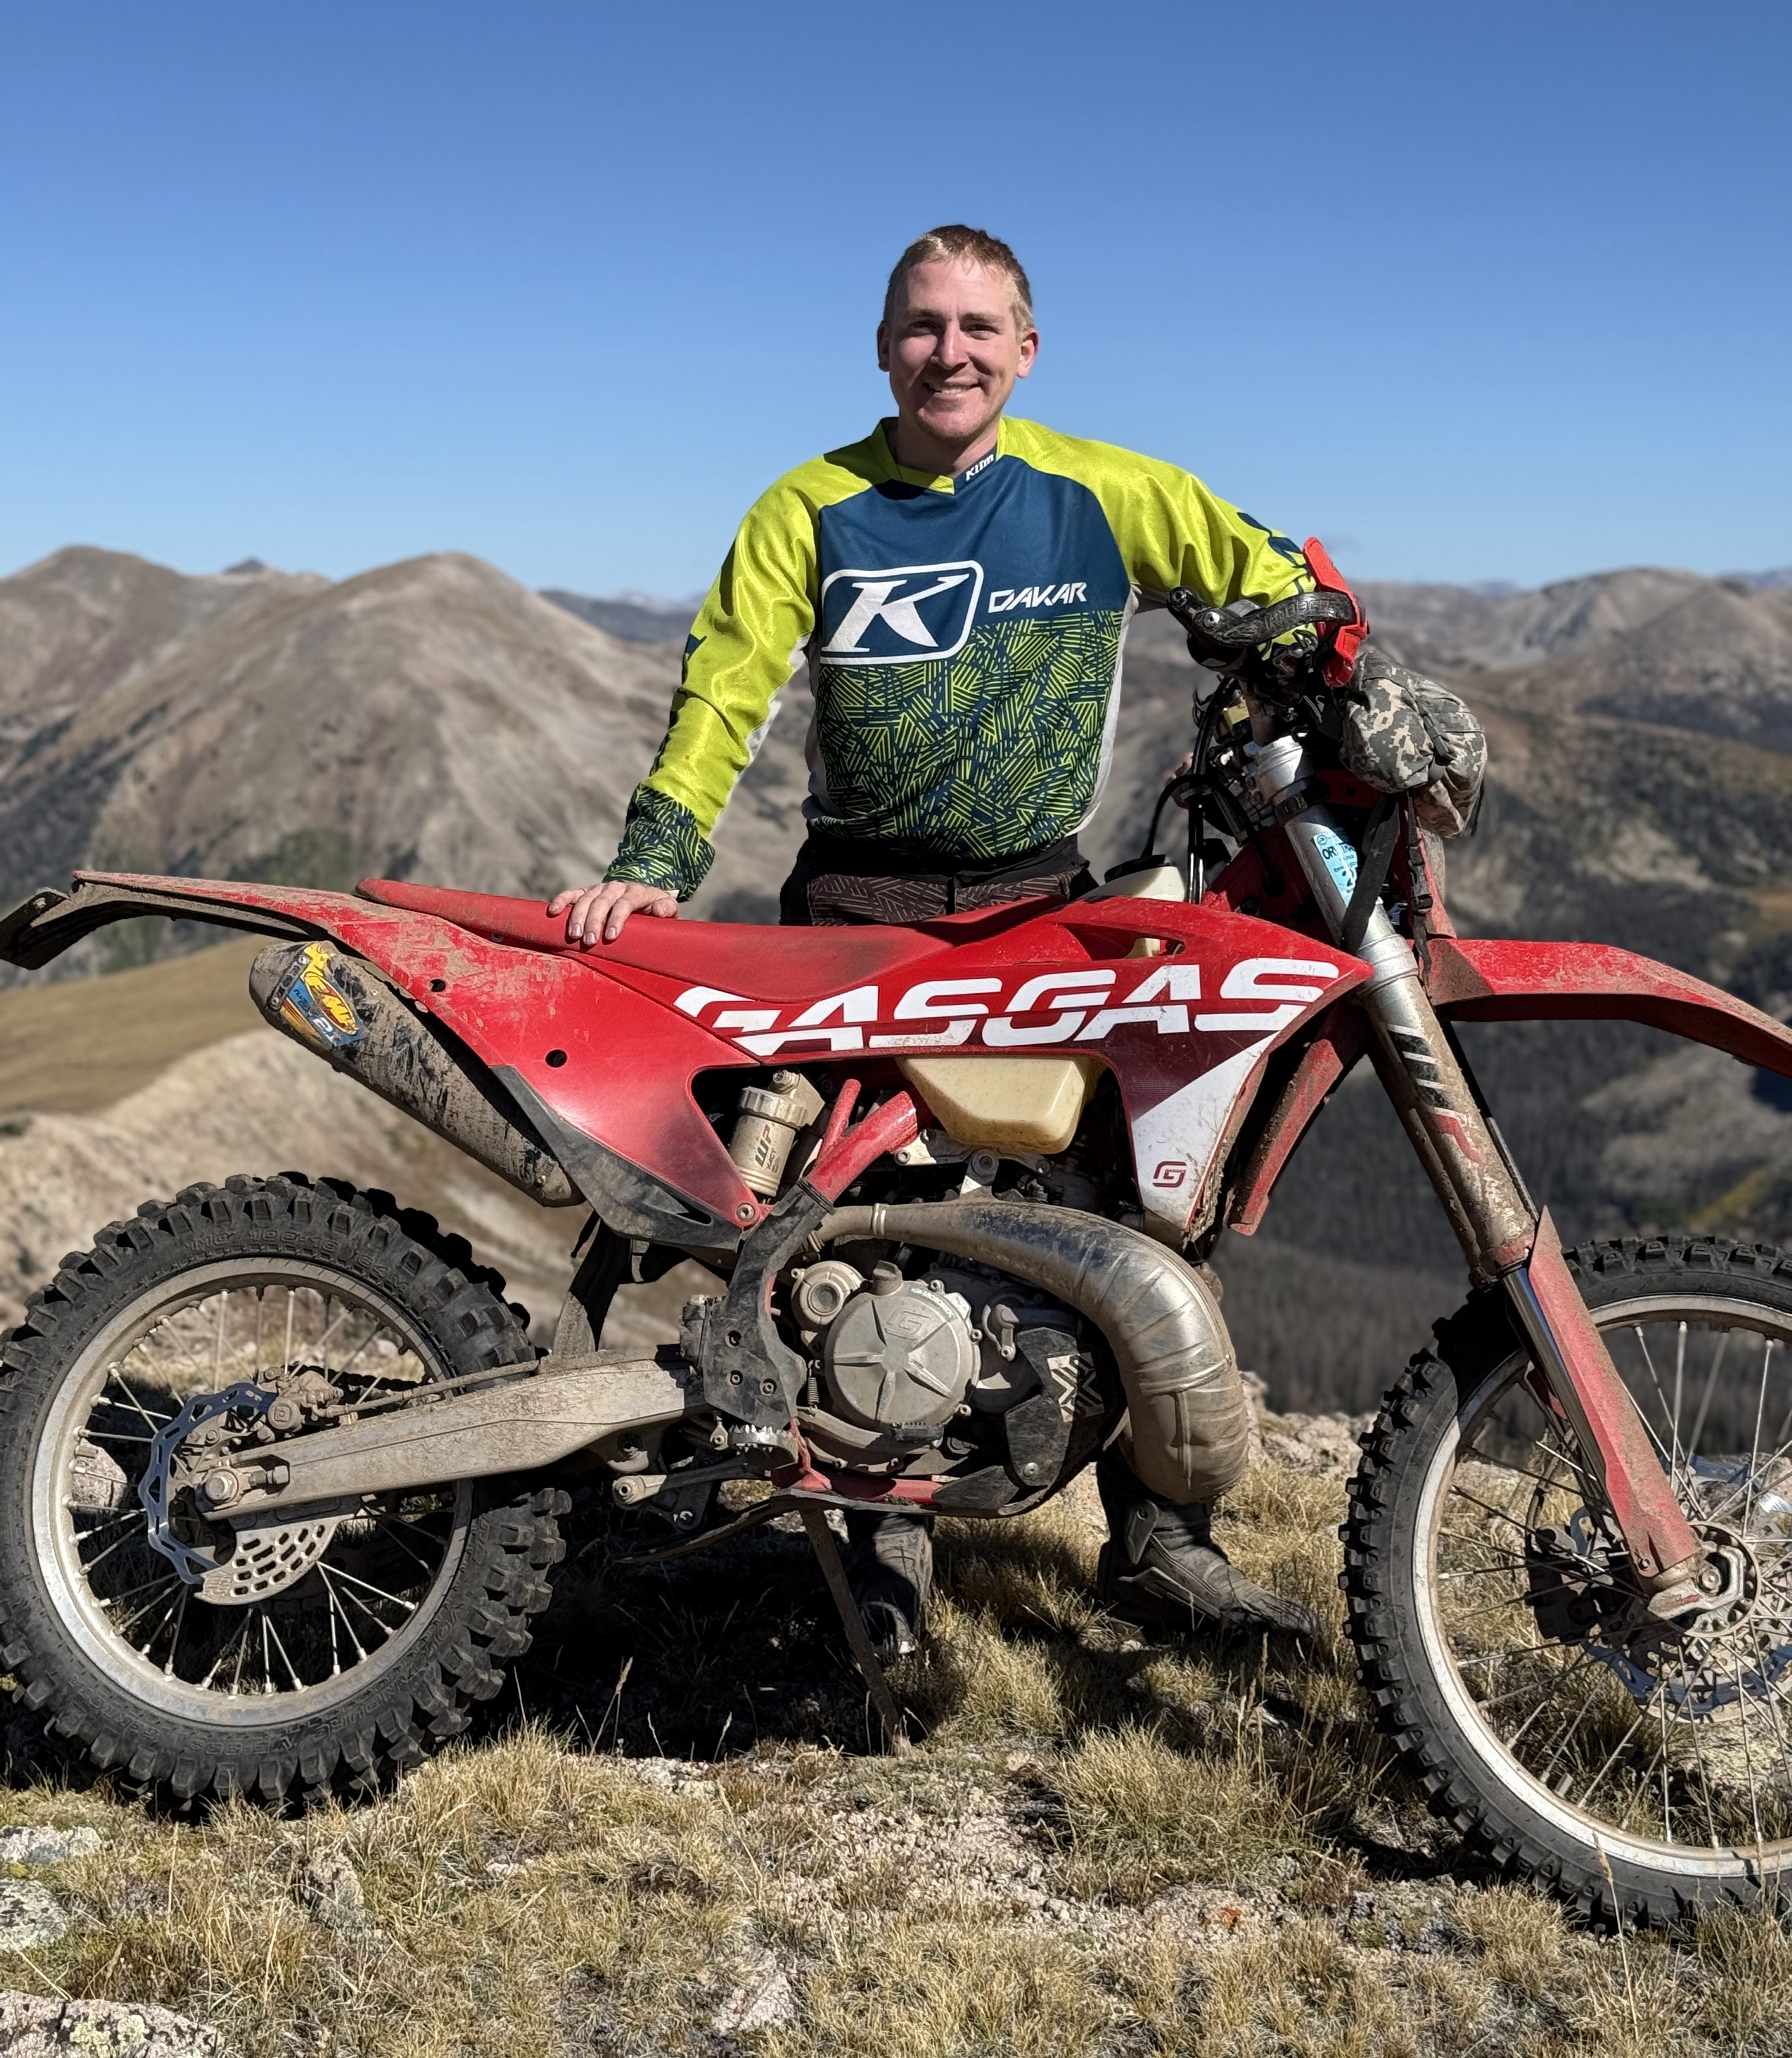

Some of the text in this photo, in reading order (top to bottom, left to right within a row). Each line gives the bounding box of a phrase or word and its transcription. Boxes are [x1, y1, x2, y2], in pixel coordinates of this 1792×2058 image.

[821, 573, 969, 653] K
[987, 581, 1087, 613] DAKAR
[674, 957, 1339, 1057] GASGAS
[755, 1124, 772, 1168] WP
